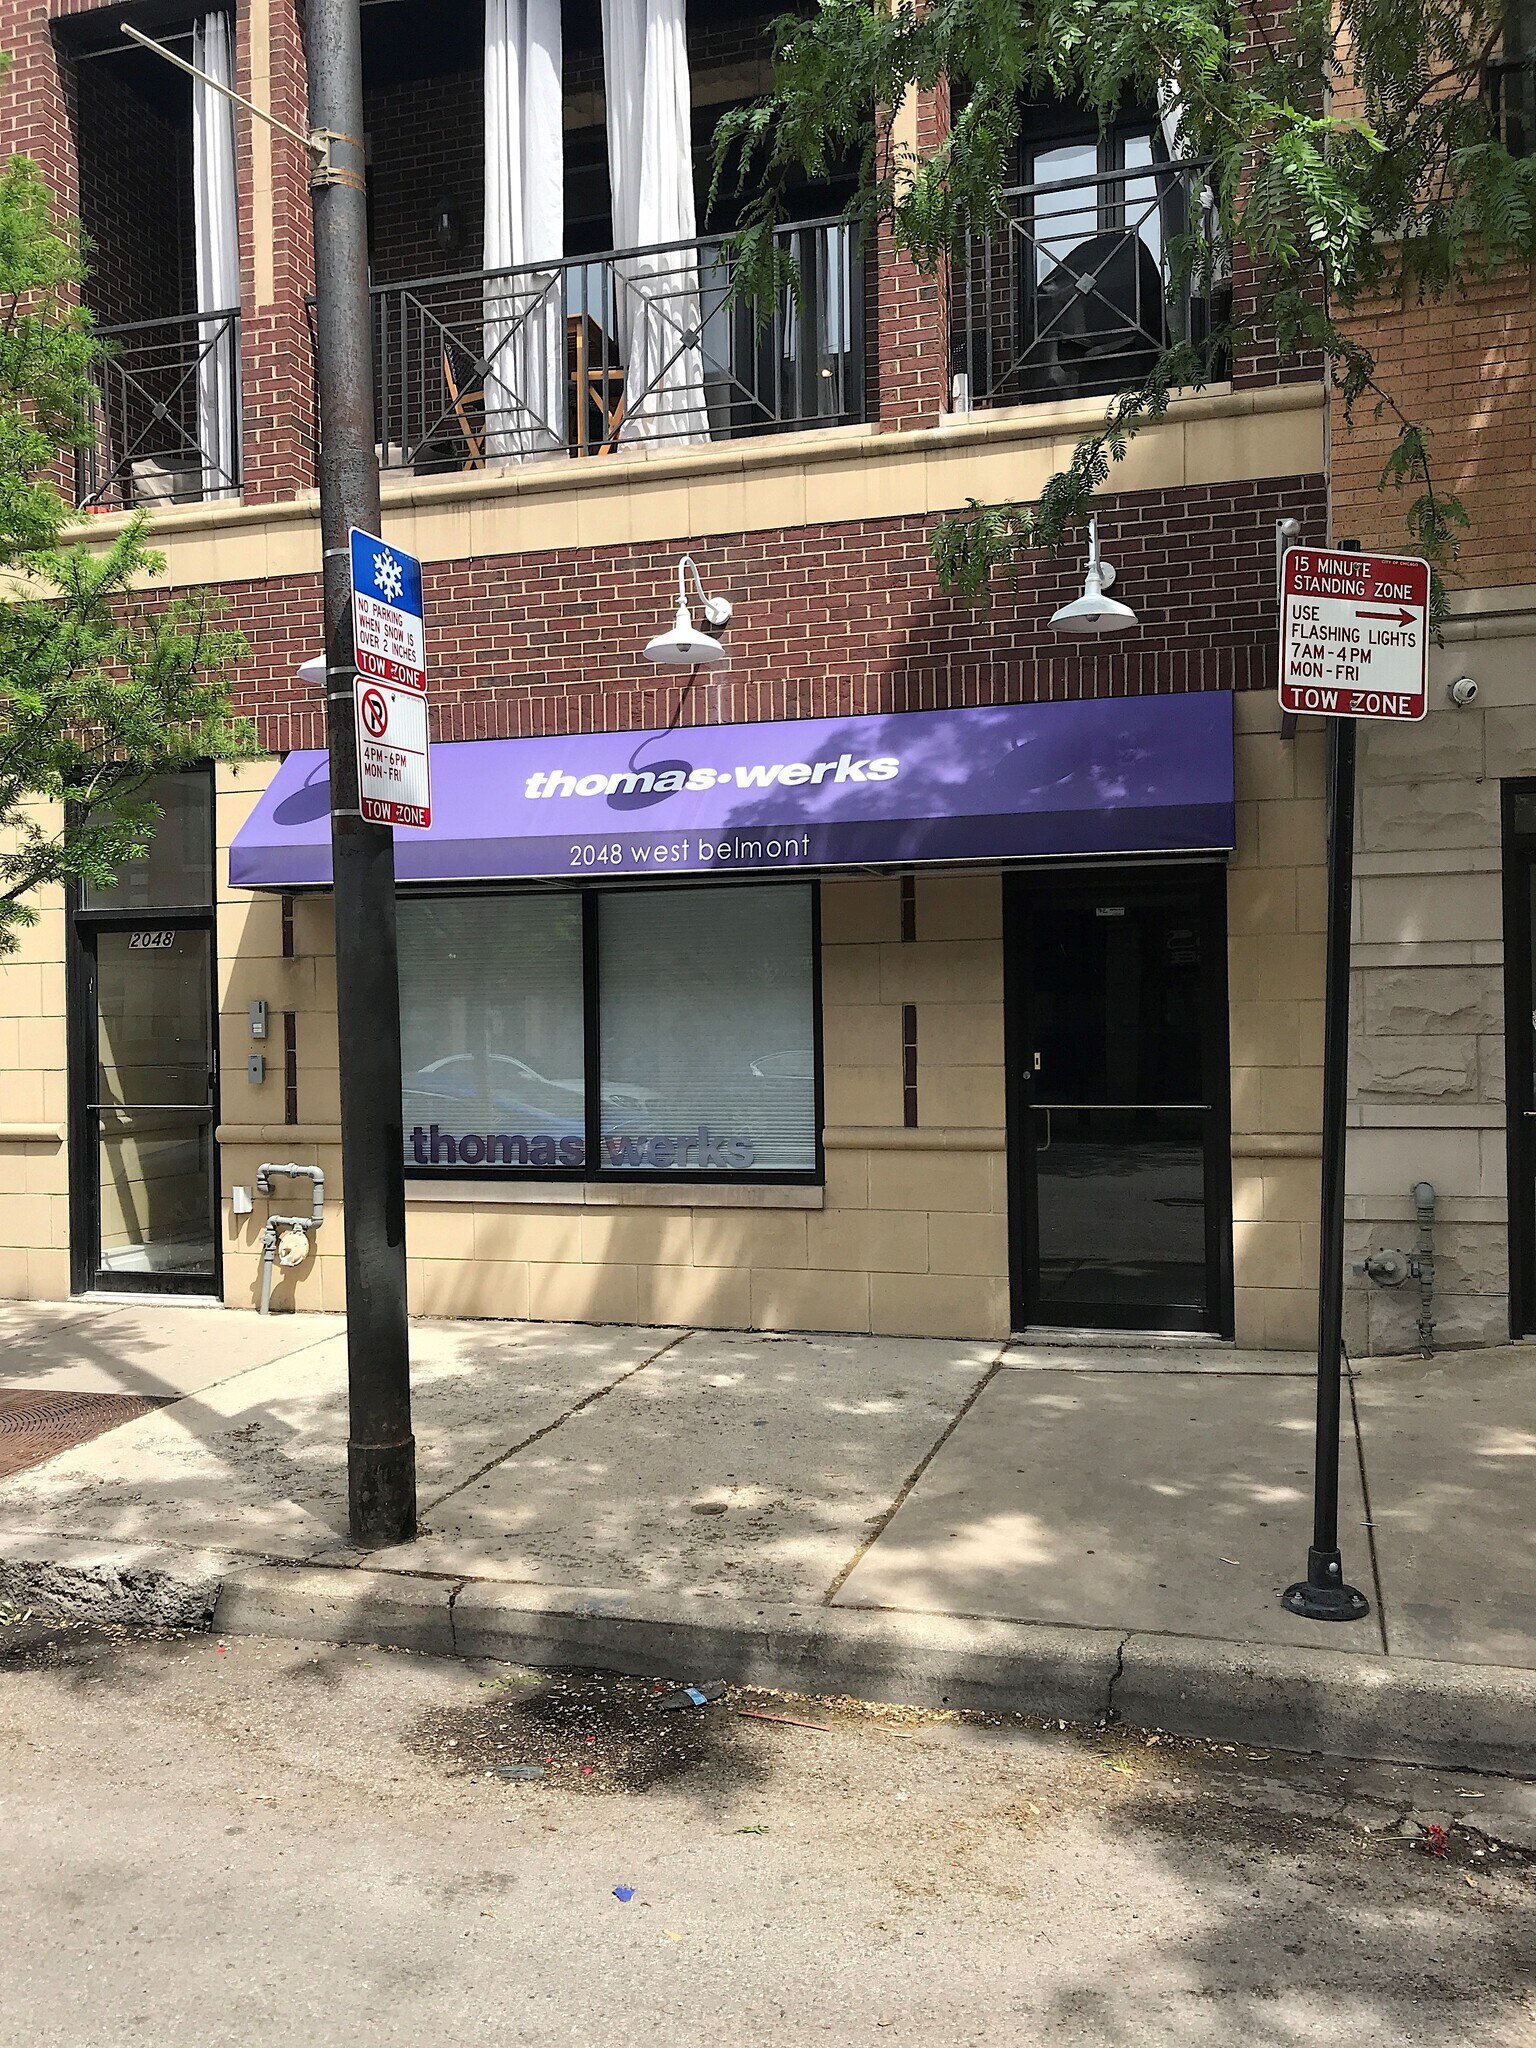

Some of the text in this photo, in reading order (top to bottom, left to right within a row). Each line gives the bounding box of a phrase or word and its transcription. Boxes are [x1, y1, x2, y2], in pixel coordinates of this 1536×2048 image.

[1294, 556, 1372, 578] 15 MINUTE
[1294, 575, 1412, 600] STANDING ZONE
[358, 598, 403, 627] NO PARKING
[1292, 605, 1319, 621] USE
[360, 615, 414, 646] WHEN SNOW IS
[1292, 624, 1416, 647] FLASHING LIGHTS
[360, 631, 416, 662] OVER 2 INCHES
[360, 652, 420, 688] TOW ZONE
[1291, 688, 1412, 715] TOW ZONE
[365, 800, 426, 825] TOW ZONE
[570, 833, 810, 866] 2048 west belmont
[131, 932, 173, 947] 2048
[410, 1125, 756, 1168] thomas werks
